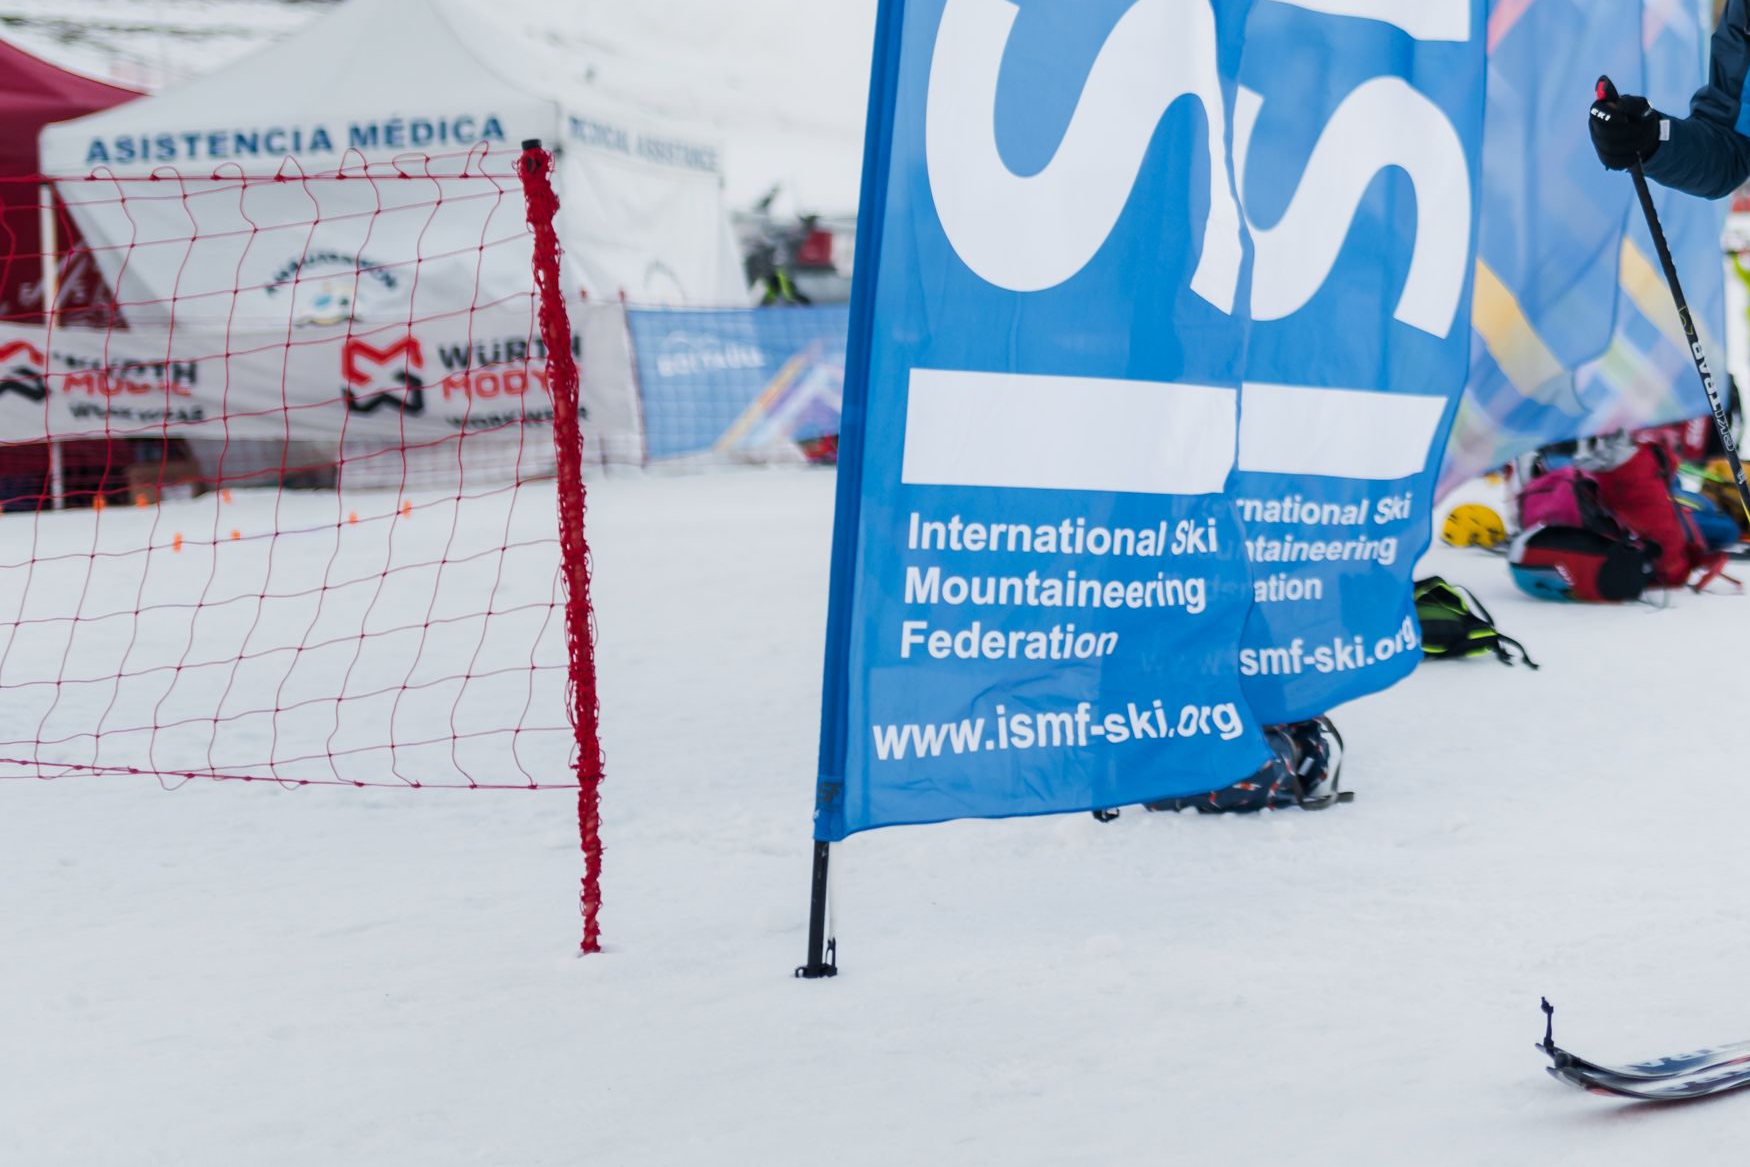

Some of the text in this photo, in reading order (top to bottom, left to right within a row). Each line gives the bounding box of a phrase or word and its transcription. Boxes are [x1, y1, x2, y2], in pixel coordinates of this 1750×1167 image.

[86, 112, 506, 165] ASISTENCIA MÉDICA
[1374, 492, 1412, 525] Ski
[907, 512, 1218, 557] International Ski
[904, 566, 1206, 614] Mountaineering
[901, 621, 1118, 661] Federation
[873, 698, 1244, 761] www.ismf-ski.org
